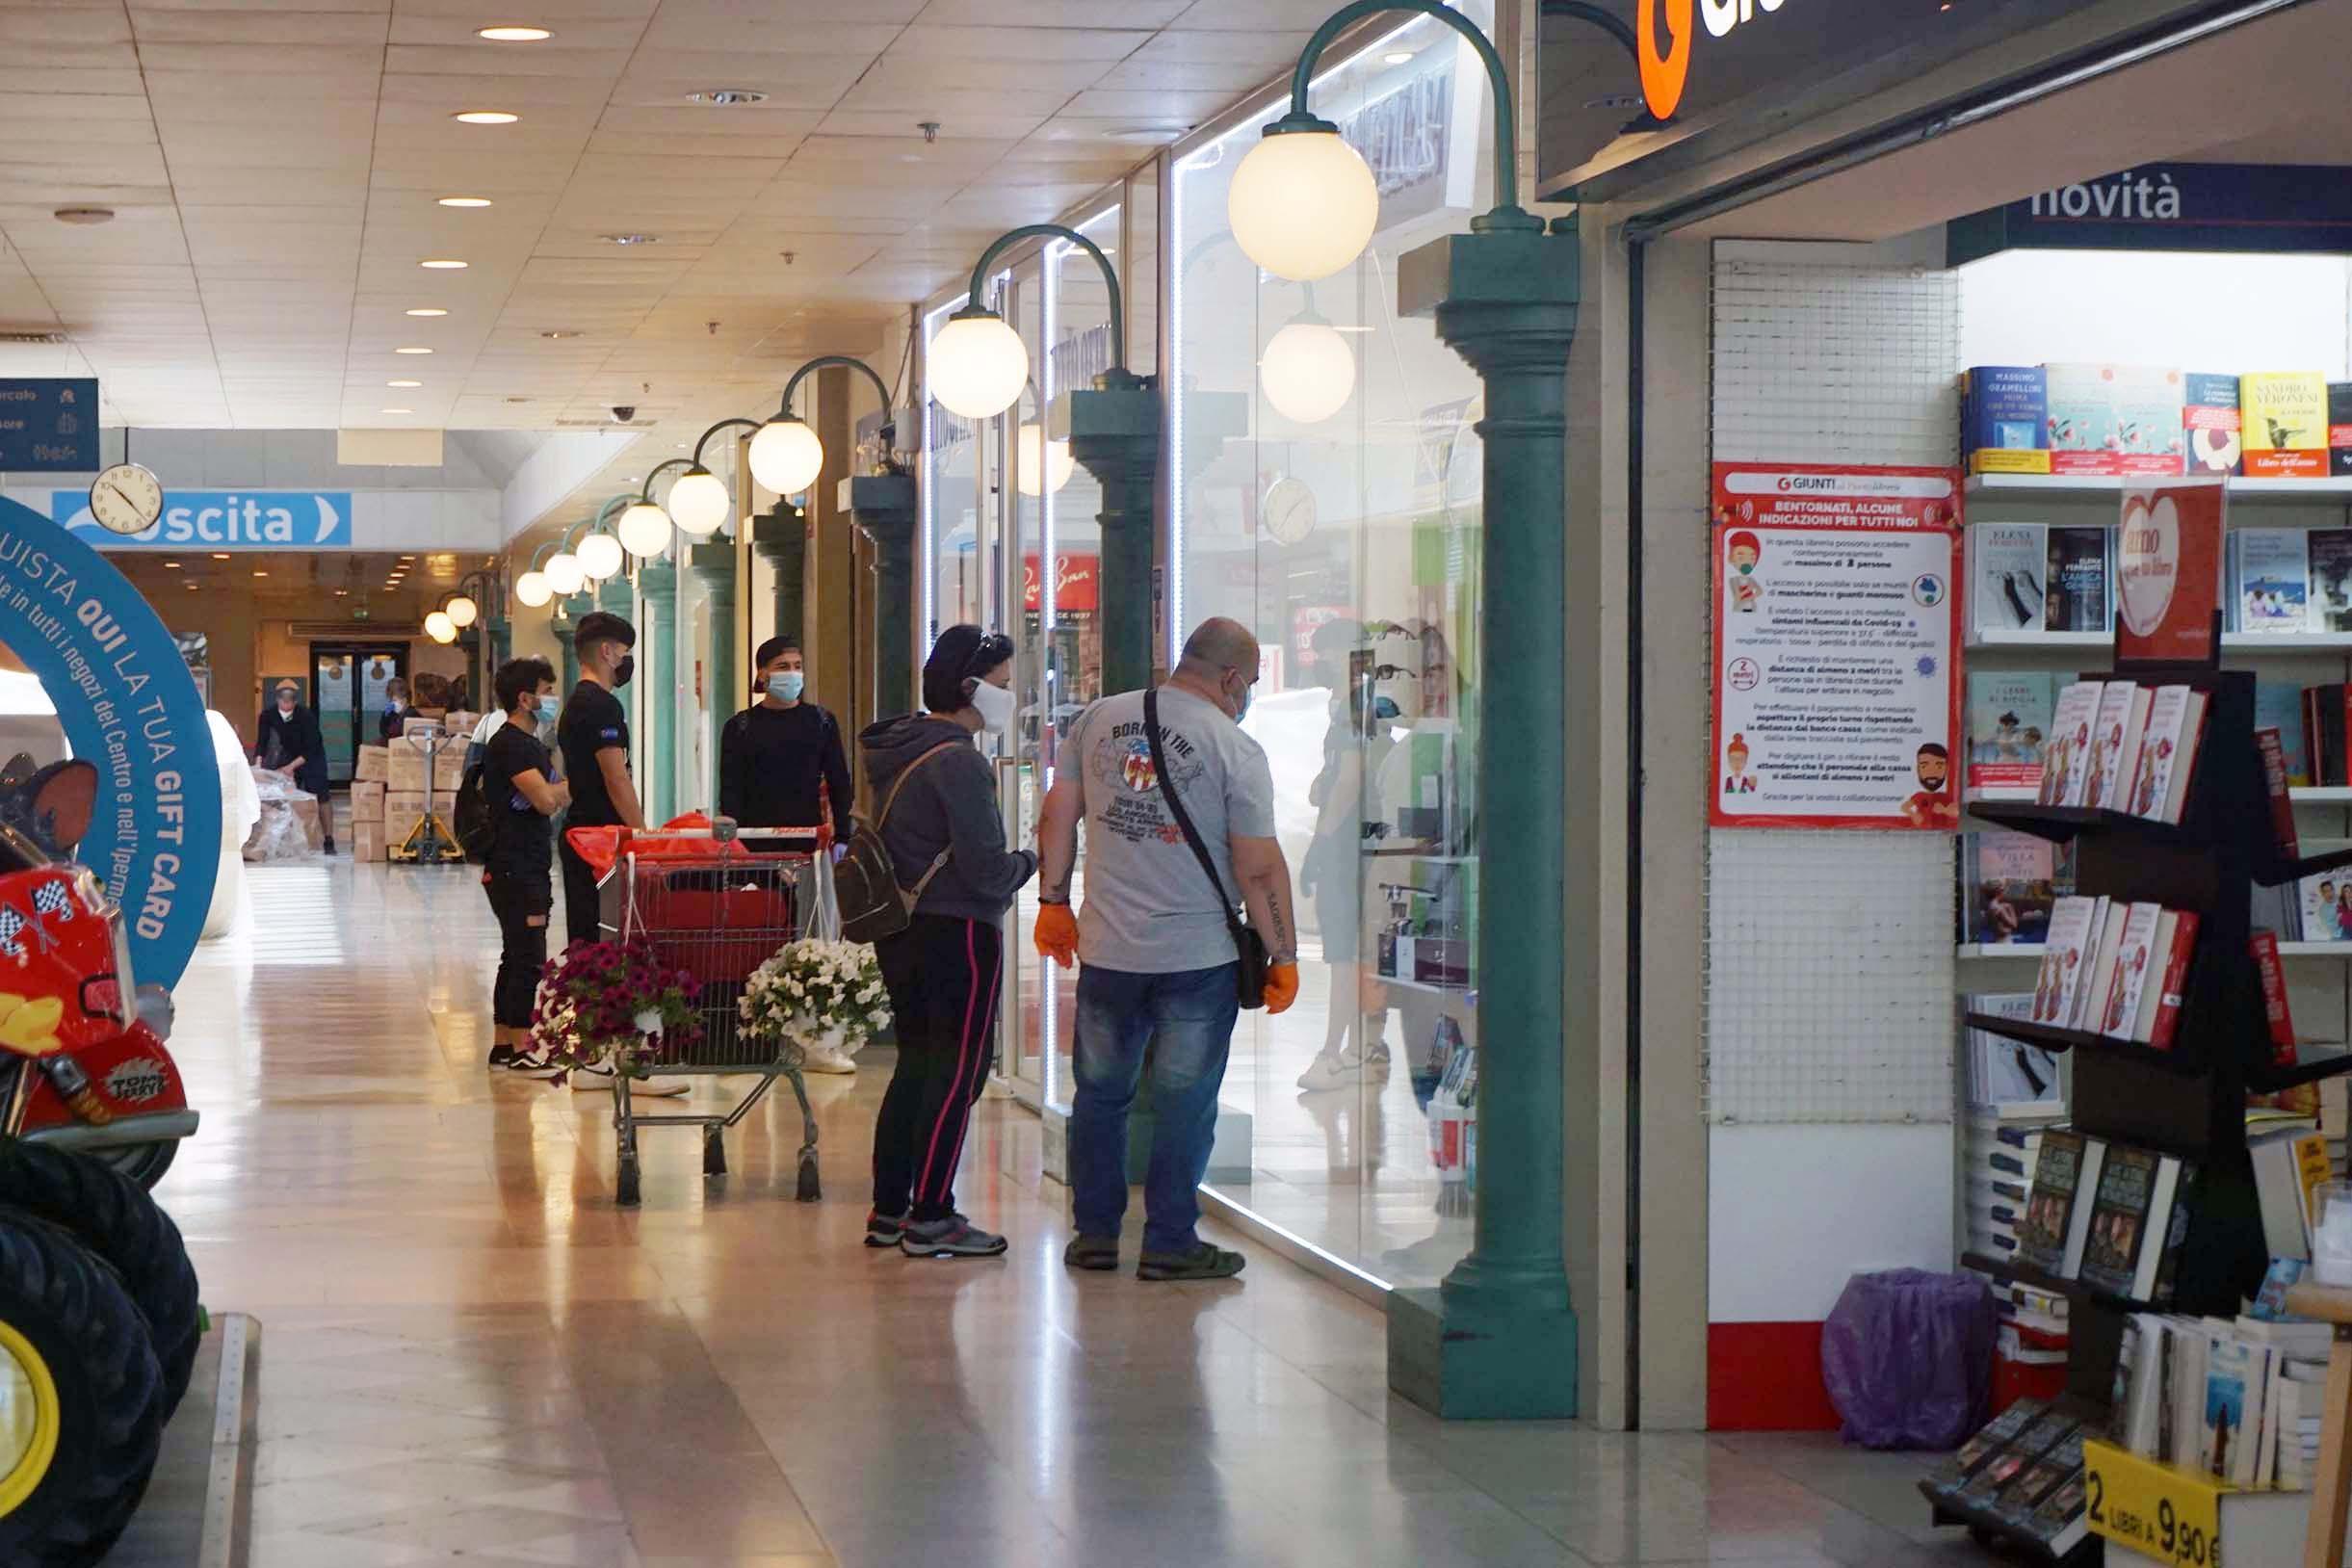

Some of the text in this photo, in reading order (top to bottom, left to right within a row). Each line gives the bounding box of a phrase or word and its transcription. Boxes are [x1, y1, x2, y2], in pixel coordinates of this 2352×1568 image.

[1793, 478, 1836, 489] GIUNTI
[1759, 511, 1833, 525] INDICAZIONI
[1835, 514, 1858, 526] PER
[1860, 515, 1895, 527] TUTTI
[1856, 504, 1903, 514] ALCUNE
[9, 588, 30, 612] in
[28, 603, 66, 642] tutti
[77, 598, 128, 653] QUI
[63, 647, 108, 700] negozi
[114, 650, 151, 695] LA
[92, 700, 121, 729] del
[138, 695, 177, 764] TUA
[105, 730, 132, 788] Centro
[1170, 734, 1195, 759] THE
[117, 793, 133, 803] e
[154, 771, 184, 846] GIFT
[136, 853, 180, 940] CARD
[2089, 1471, 2104, 1524] 2
